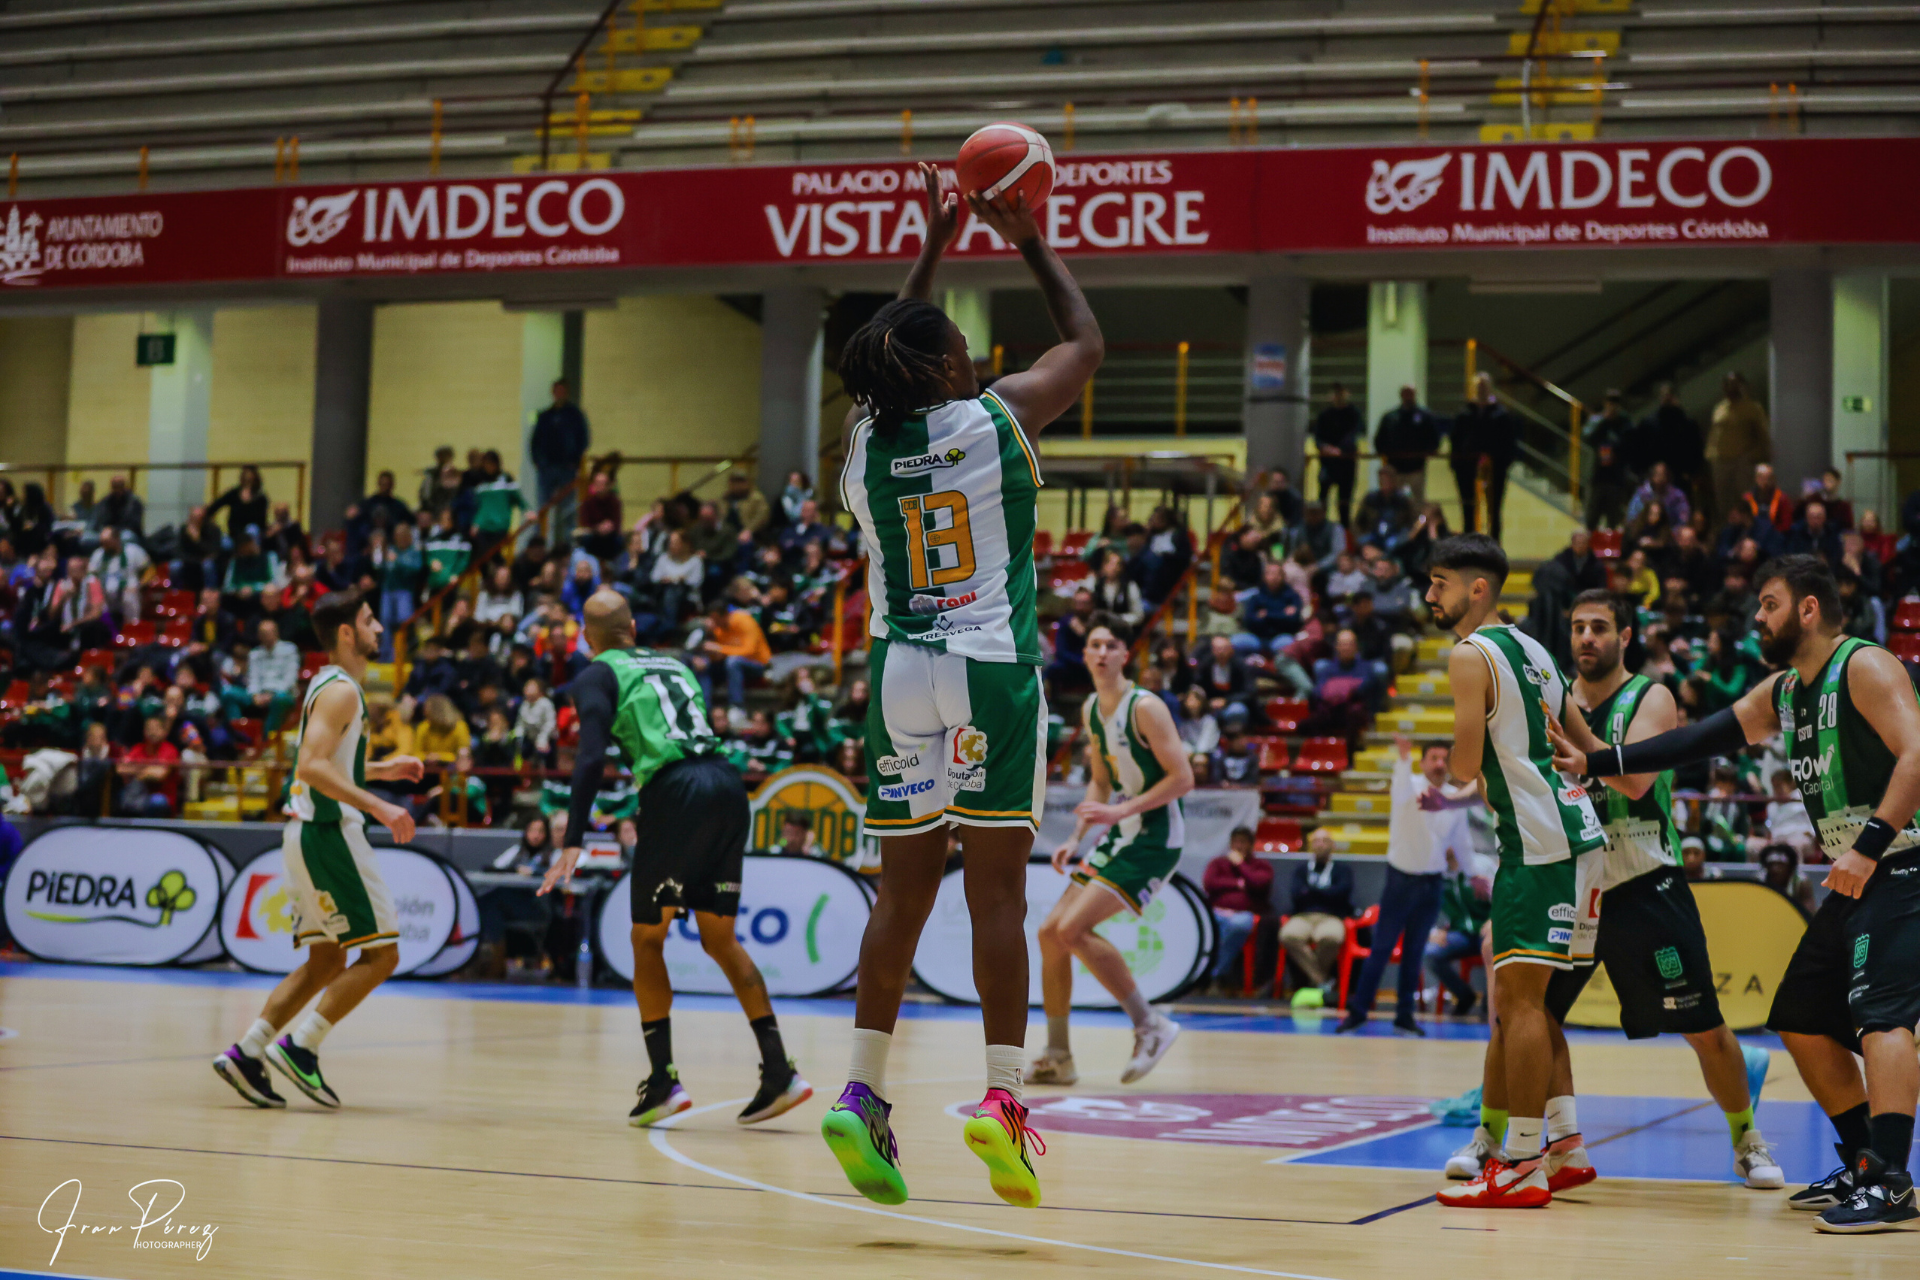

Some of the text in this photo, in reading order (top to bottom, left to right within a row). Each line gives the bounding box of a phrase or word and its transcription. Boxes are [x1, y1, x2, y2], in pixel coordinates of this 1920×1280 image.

[792, 168, 900, 196] PALACIO
[1053, 159, 1173, 188] DEPORTES
[1458, 146, 1773, 212] IMDECO
[363, 178, 626, 242] IMDECO
[765, 190, 1210, 258] VISTA AEGRE
[1553, 220, 1582, 241] de
[1585, 219, 1679, 244] Deportes
[903, 499, 918, 511] CCB
[898, 489, 977, 591] 13
[643, 674, 714, 740] 11
[1817, 691, 1838, 731] 28
[1612, 712, 1625, 745] 9
[878, 753, 920, 774] efficold
[1788, 744, 1835, 782] ROW
[1803, 776, 1835, 796] Capital
